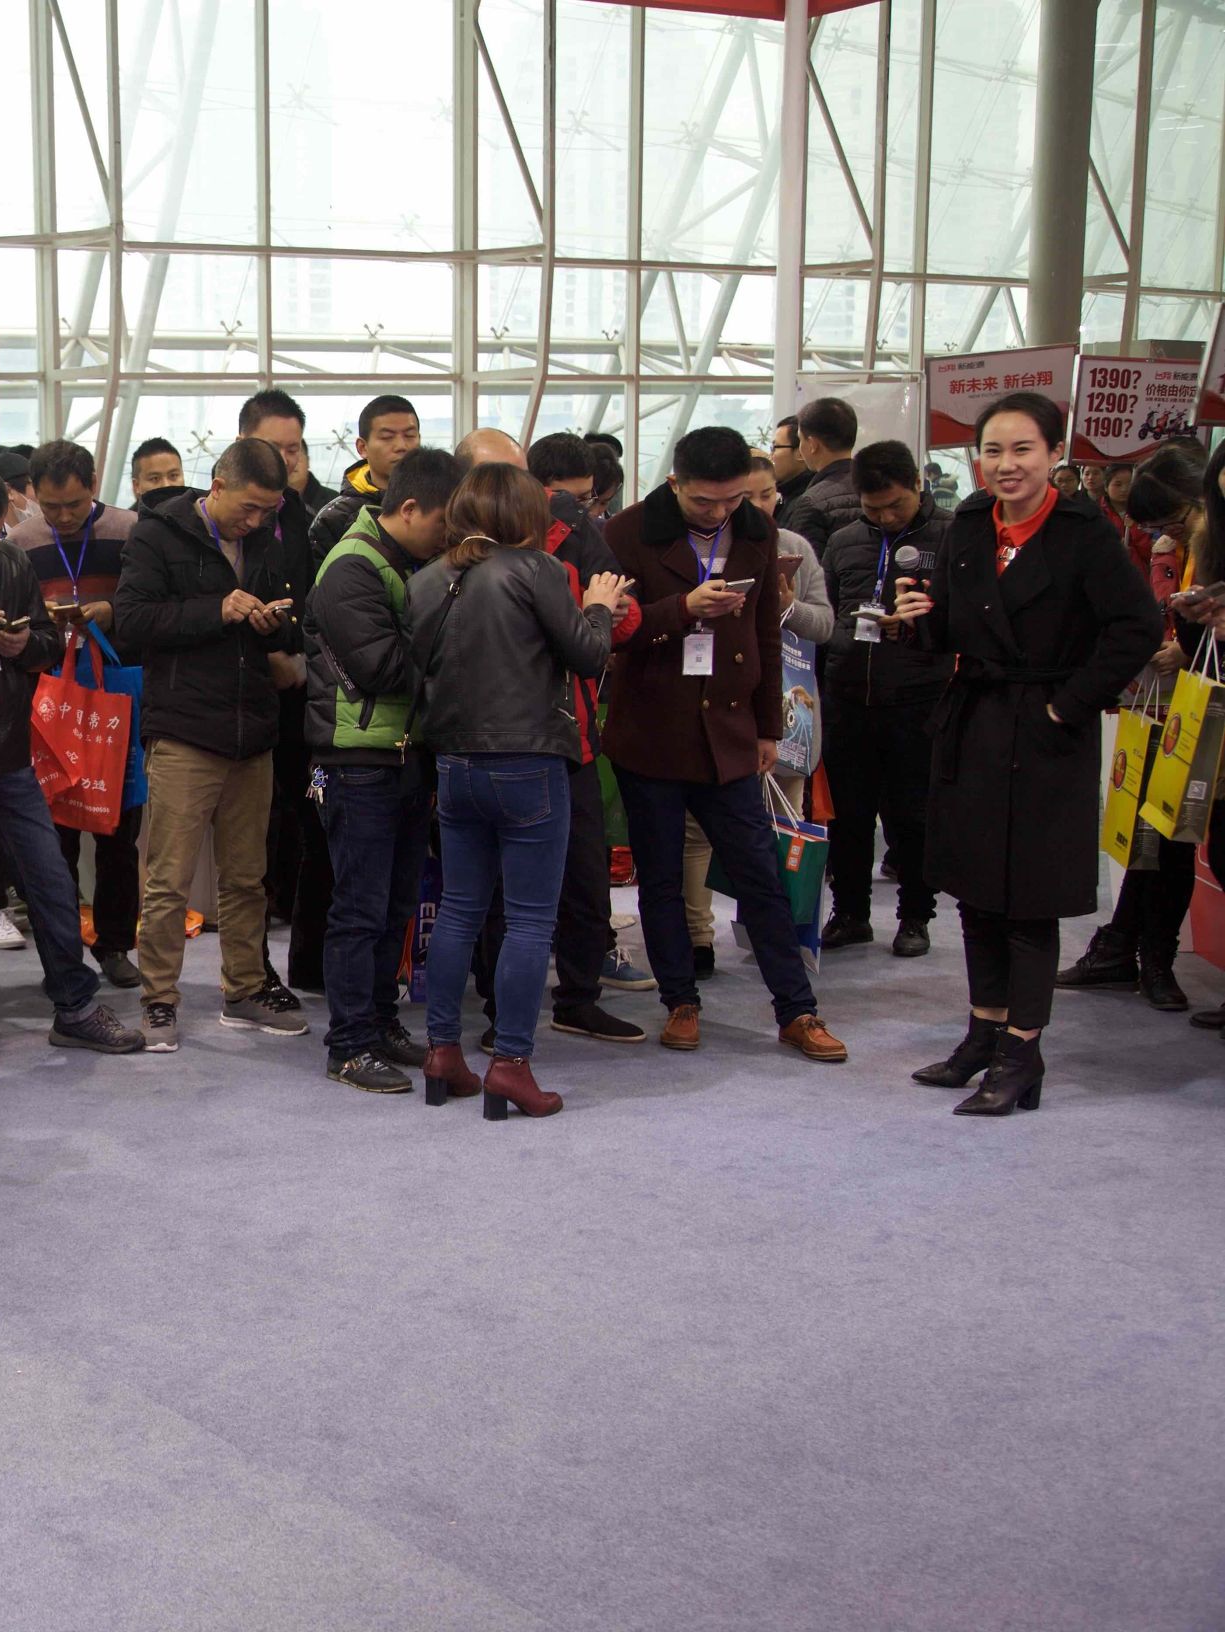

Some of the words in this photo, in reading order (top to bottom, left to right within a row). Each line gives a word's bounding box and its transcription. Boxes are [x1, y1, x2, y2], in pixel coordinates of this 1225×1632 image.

[948, 376, 998, 395] 新未来
[1003, 371, 1053, 389] 新台翔
[1089, 367, 1142, 389] 1390?
[1086, 392, 1139, 414] 1290?
[1084, 416, 1134, 439] 1190?
